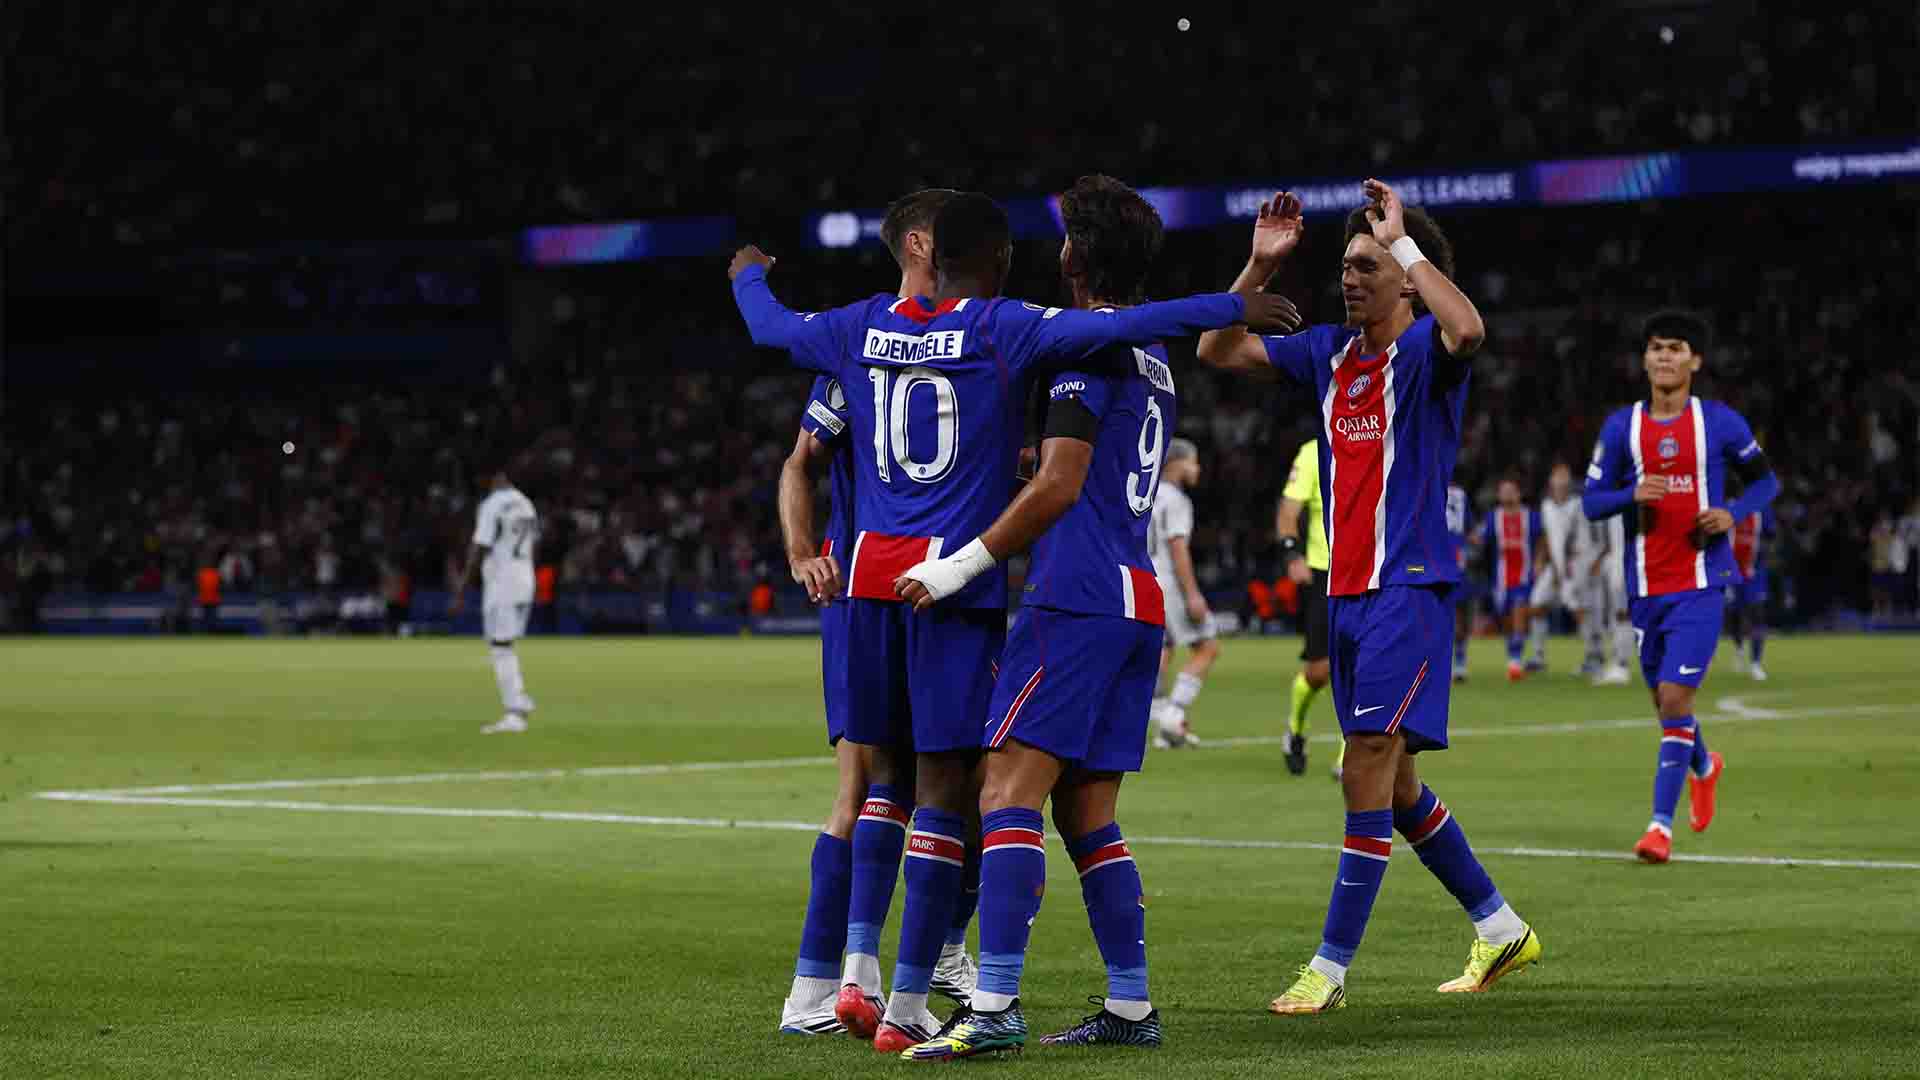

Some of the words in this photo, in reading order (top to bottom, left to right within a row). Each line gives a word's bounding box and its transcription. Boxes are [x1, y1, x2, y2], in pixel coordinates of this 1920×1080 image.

[1423, 173, 1514, 204] LEAGUE
[868, 367, 959, 483] 10
[1336, 414, 1380, 435] QATAR
[1347, 431, 1381, 441] AIRWAYS
[1126, 396, 1164, 517] 9
[865, 804, 890, 816] PARIS
[911, 838, 935, 851] PARIS
